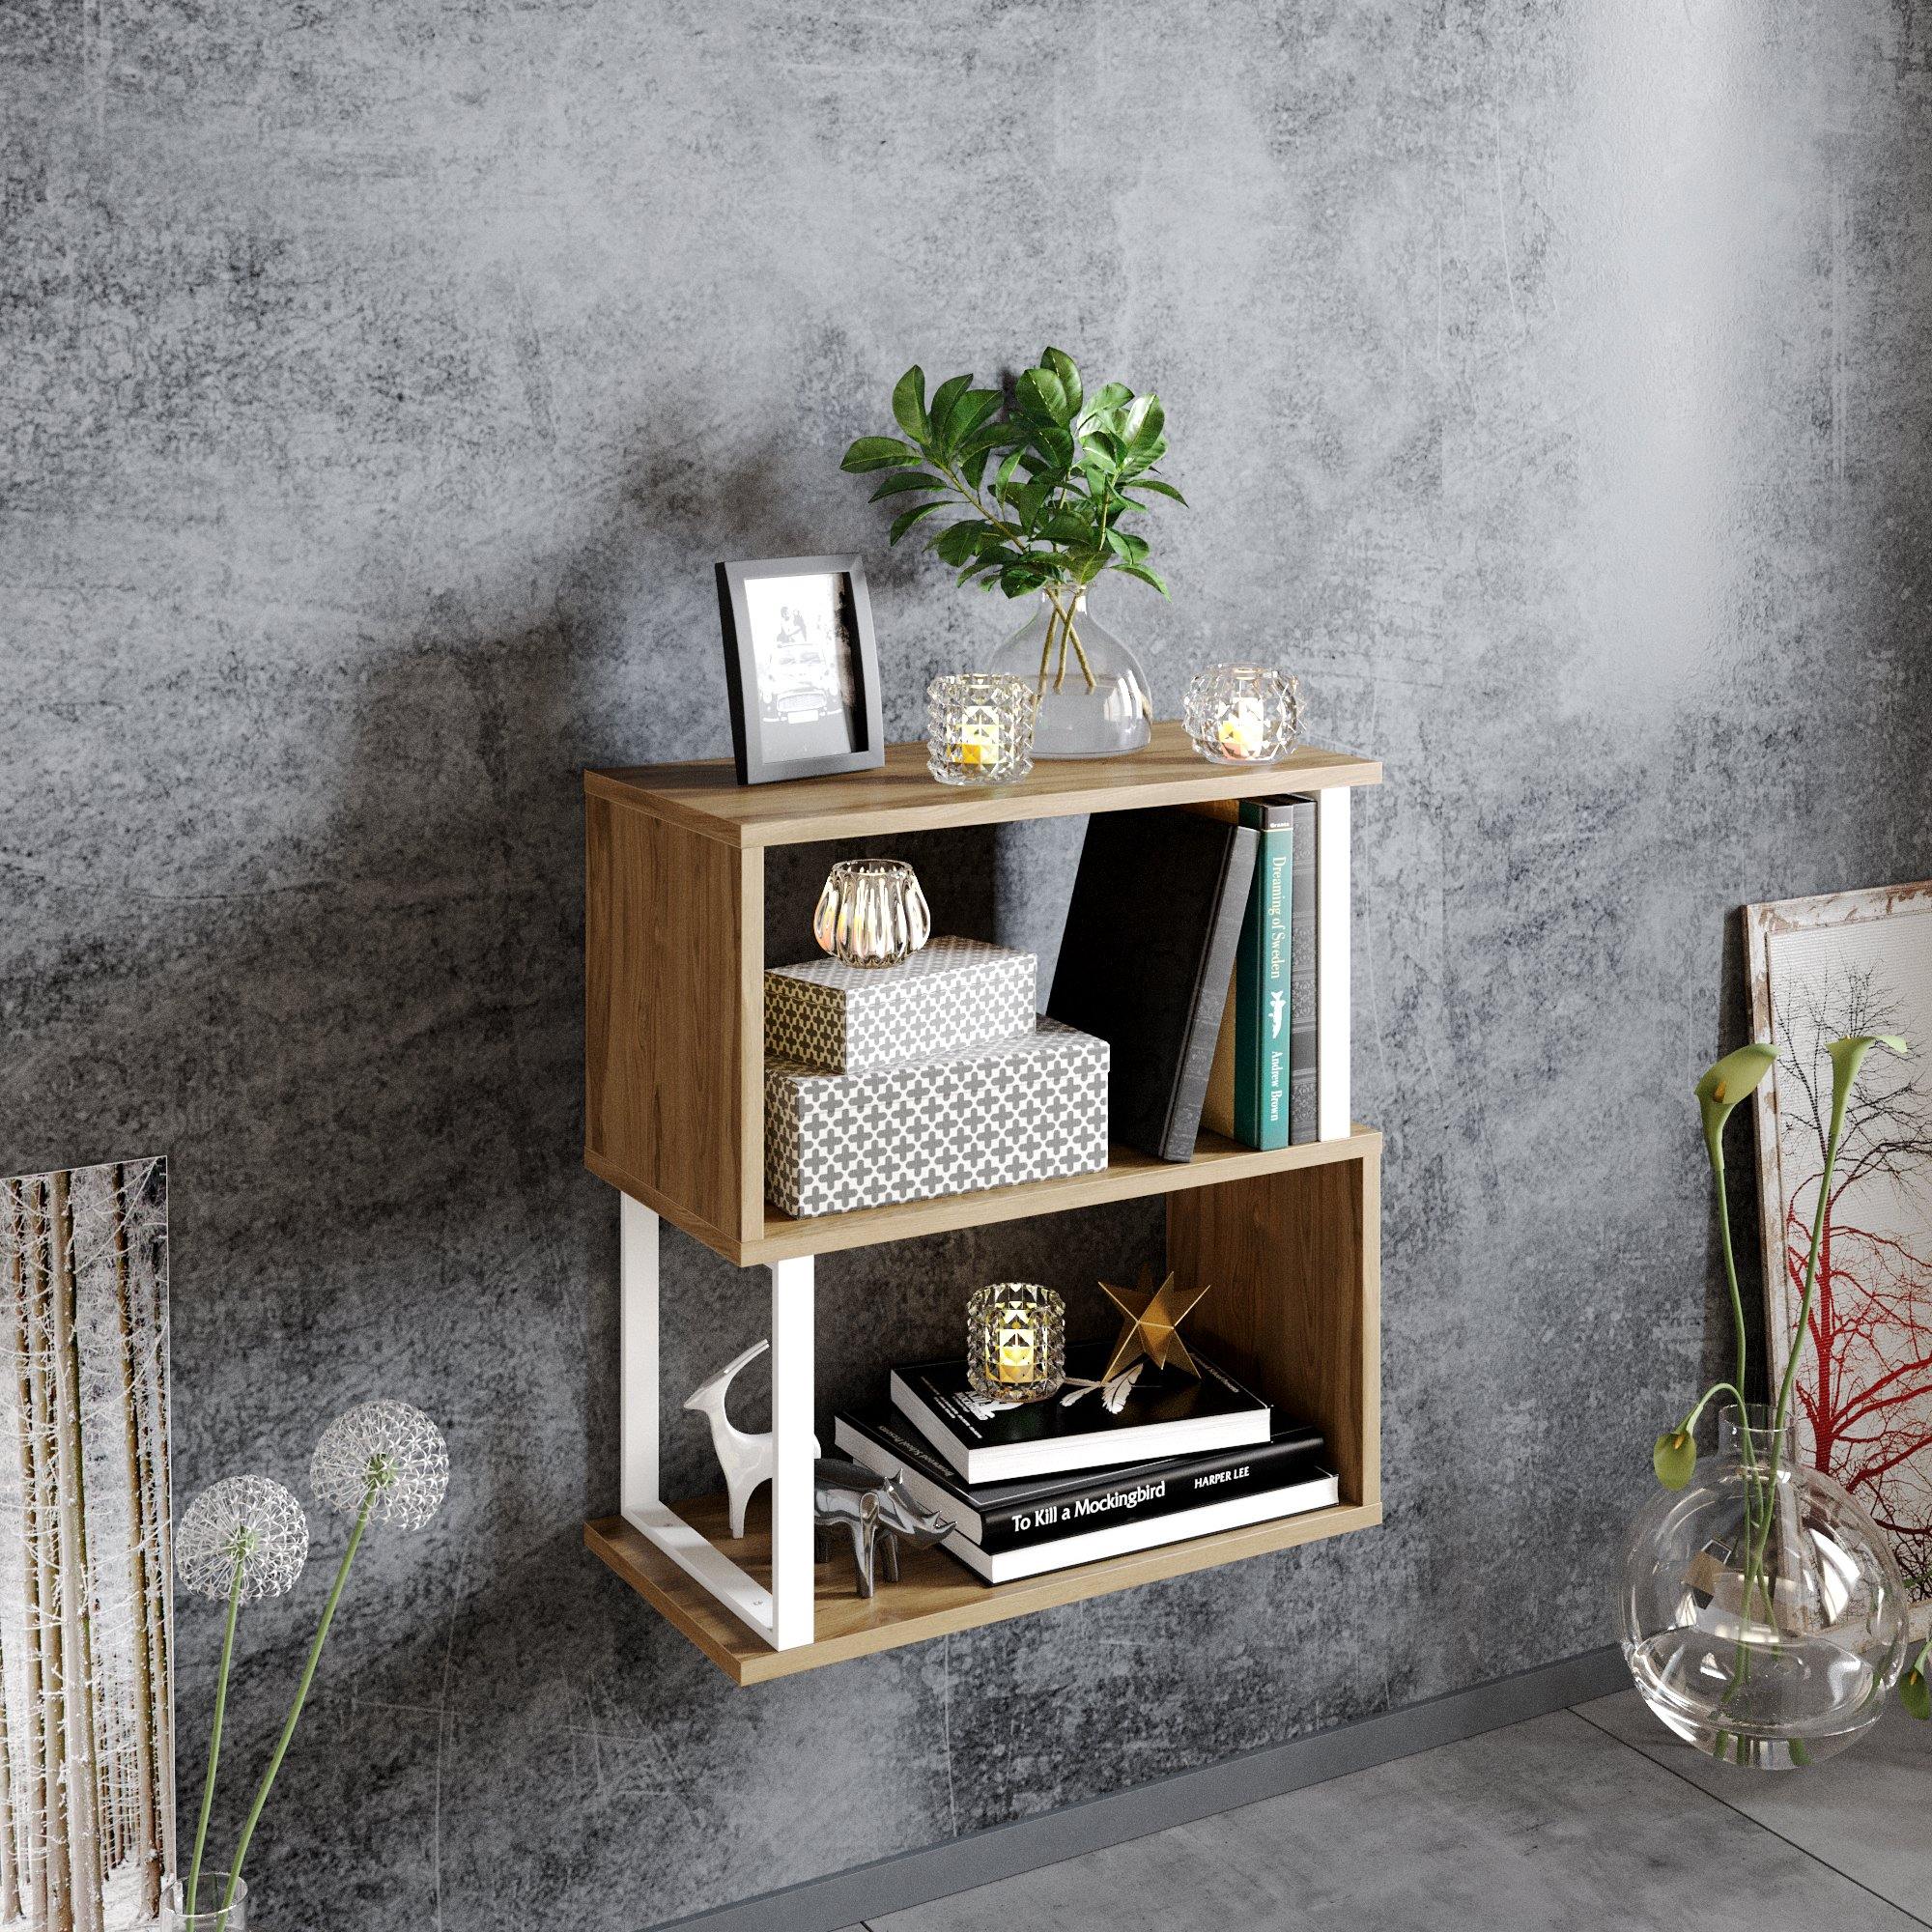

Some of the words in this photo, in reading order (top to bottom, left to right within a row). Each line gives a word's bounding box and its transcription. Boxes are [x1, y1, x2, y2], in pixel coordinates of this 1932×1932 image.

[1268, 856, 1287, 916] Dreaming
[1271, 918, 1286, 929] of
[1270, 932, 1286, 979] Sweden
[1271, 1051, 1284, 1088] Andrew
[1270, 1090, 1283, 1122] Brown
[1194, 1472, 1232, 1490] HARPER
[1233, 1465, 1250, 1480] LEE
[1011, 1515, 1032, 1532] To
[1035, 1505, 1058, 1527] Kill
[1061, 1507, 1071, 1520] a
[1074, 1480, 1166, 1519] Mockingbird
